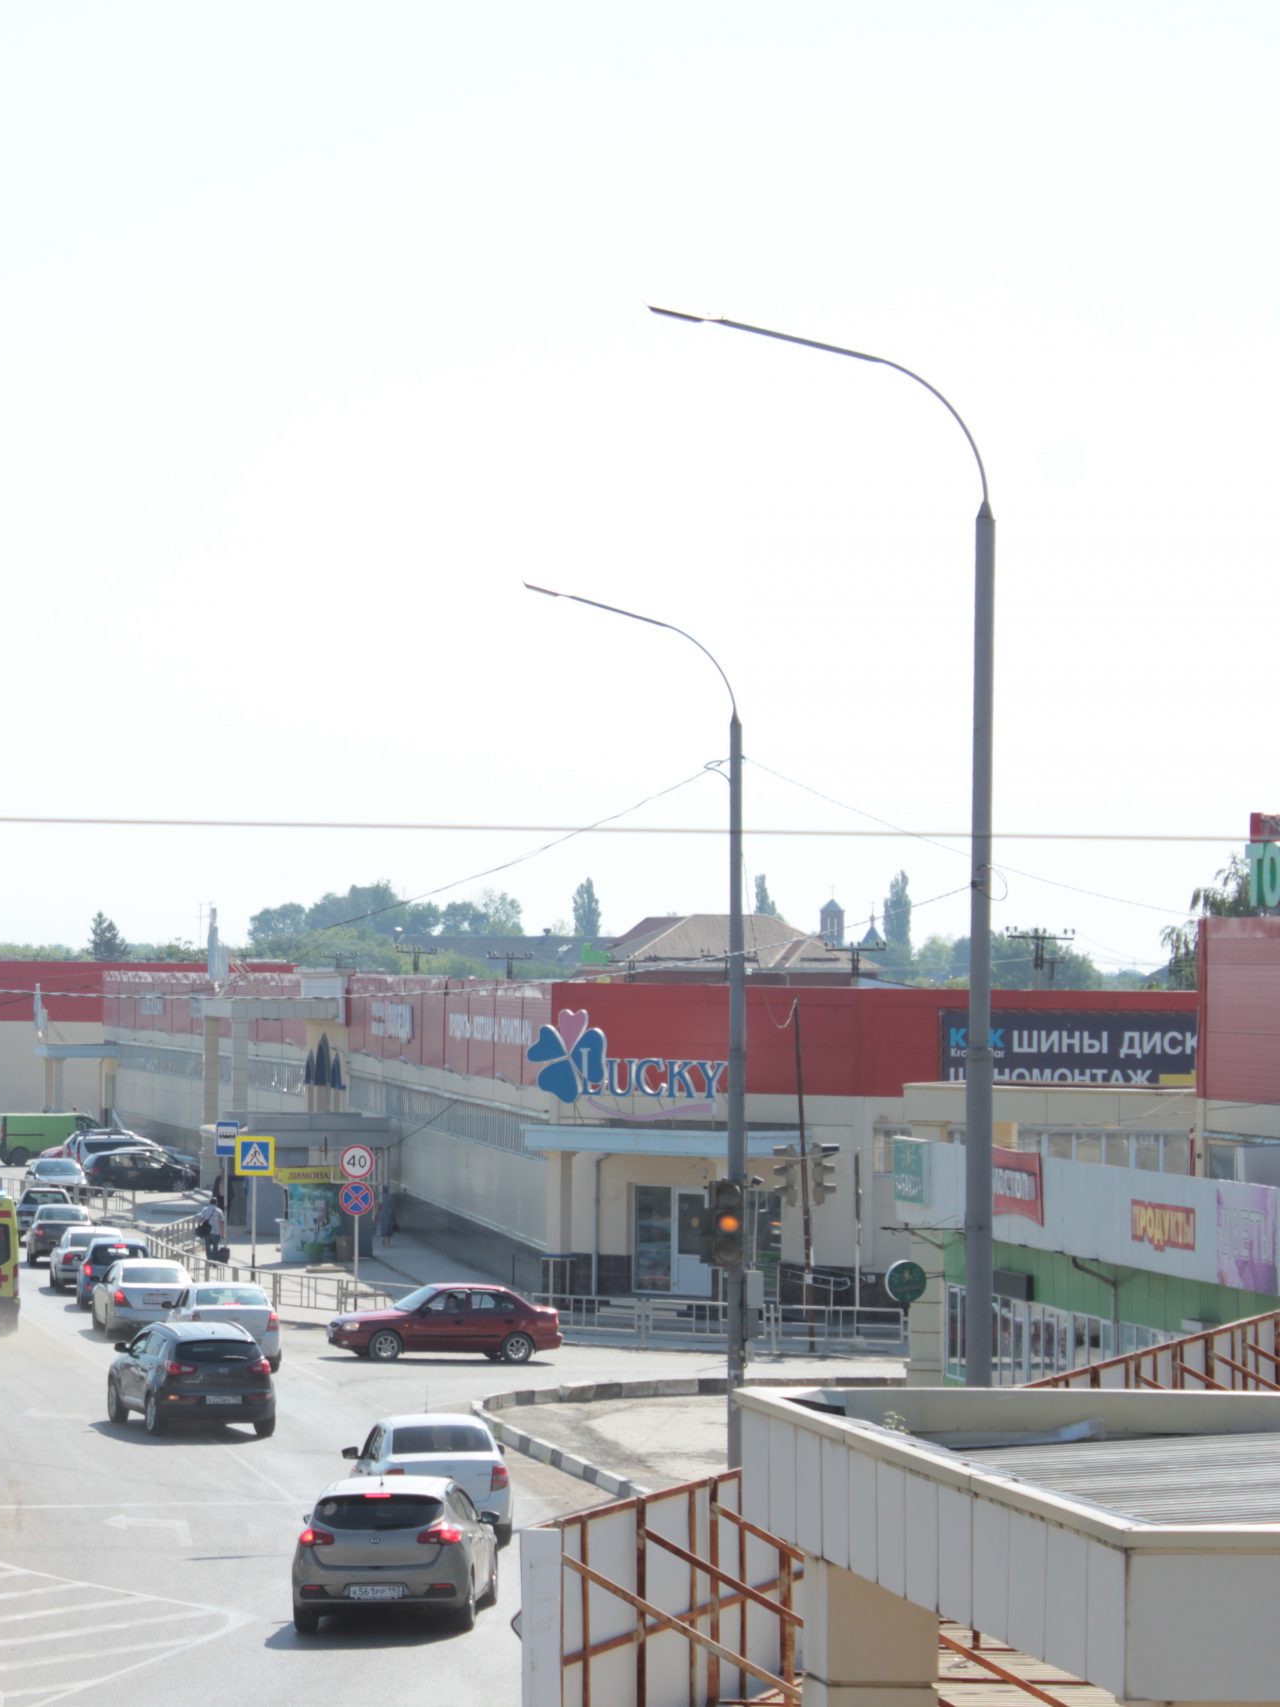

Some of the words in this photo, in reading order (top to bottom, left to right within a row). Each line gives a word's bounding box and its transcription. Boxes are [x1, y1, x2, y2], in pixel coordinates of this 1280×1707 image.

[1012, 1029, 1108, 1054] ШИНЫ
[579, 1048, 728, 1099] LUCKY
[346, 1155, 367, 1168] 40
[1132, 1204, 1194, 1246] ПРОДУКТЫ
